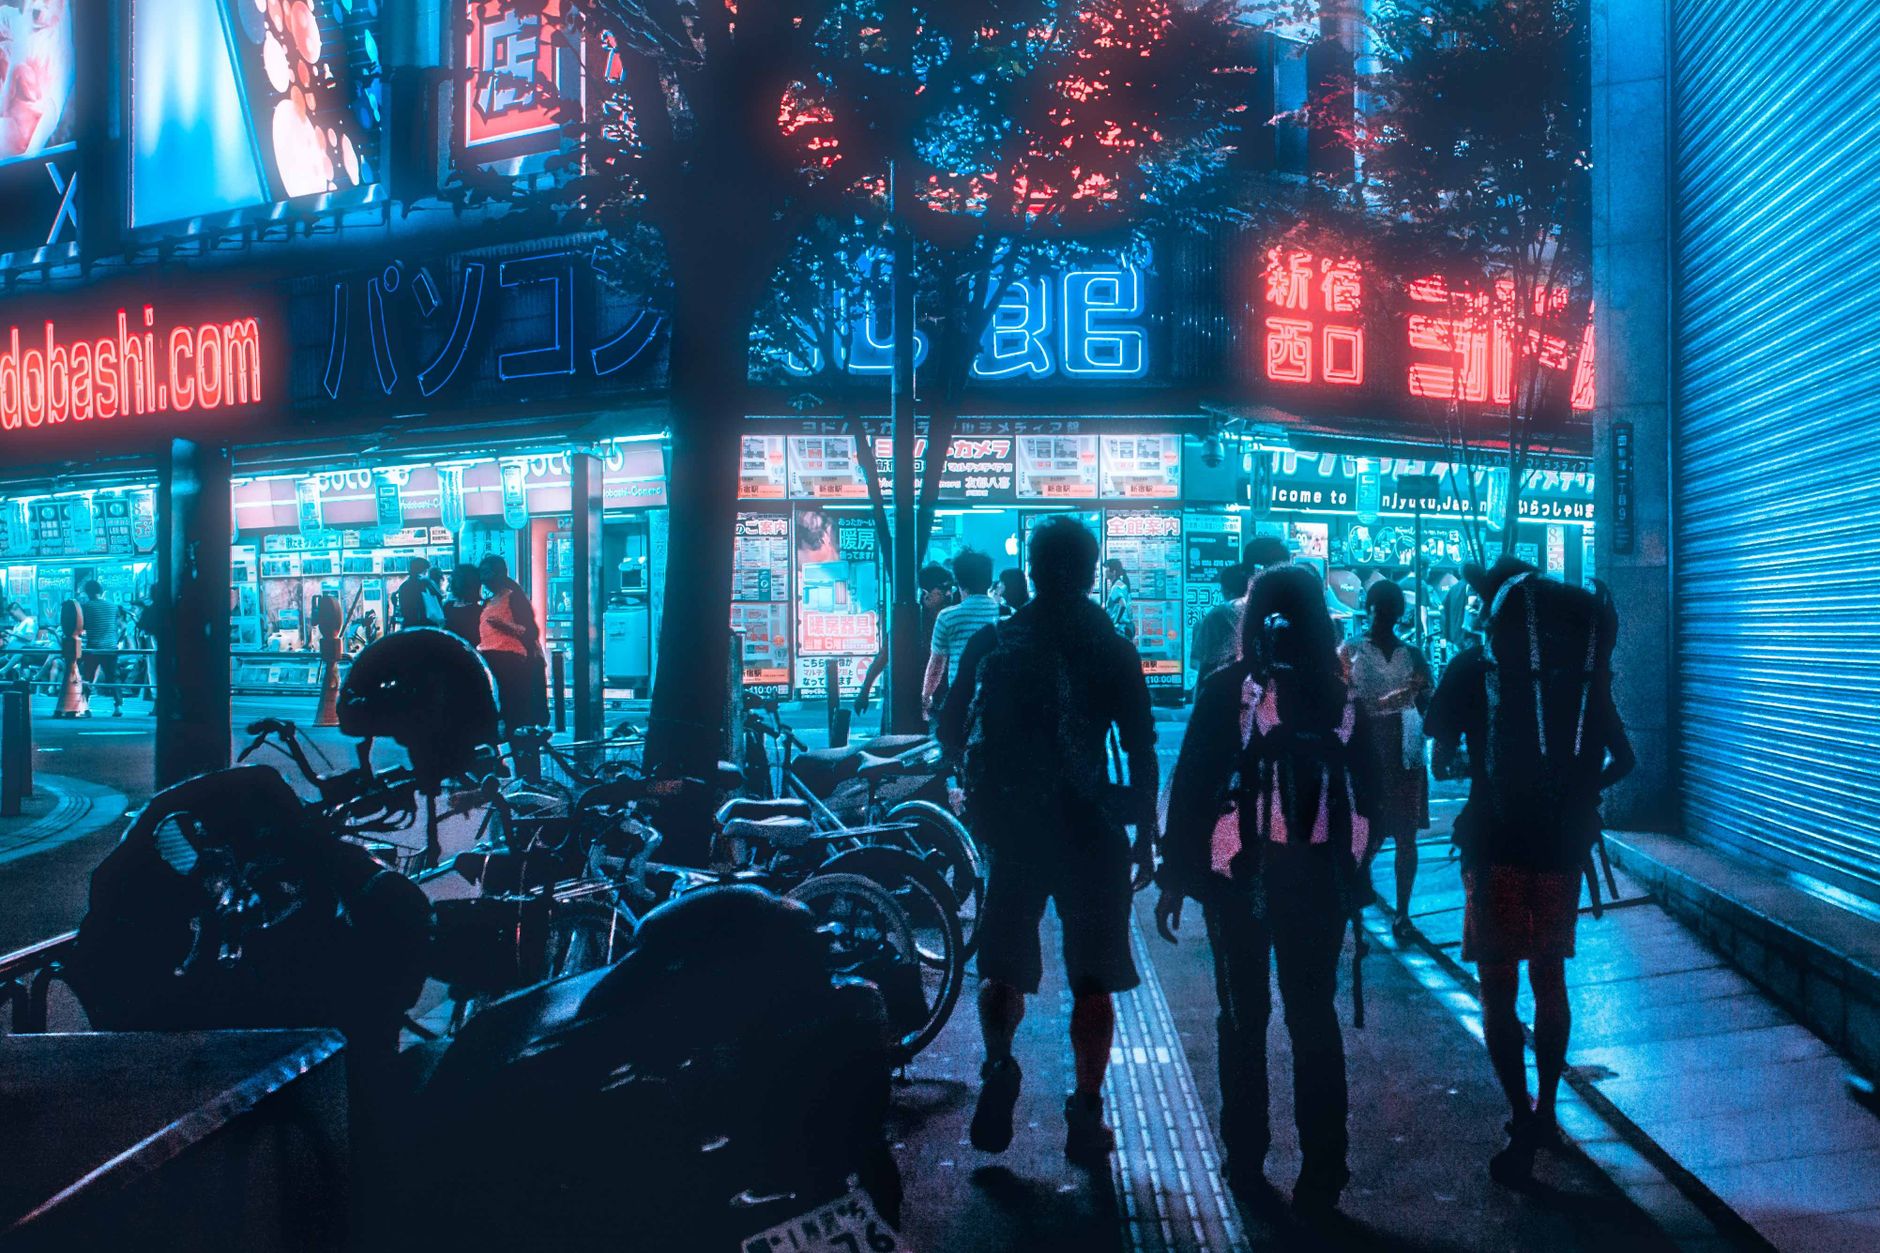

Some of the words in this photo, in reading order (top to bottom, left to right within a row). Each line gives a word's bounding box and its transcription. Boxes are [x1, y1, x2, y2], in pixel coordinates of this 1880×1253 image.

[1265, 246, 1363, 313] 新宿
[0, 305, 262, 430] dobashi.com
[1265, 316, 1365, 386] 西口
[1330, 490, 1348, 505] to
[838, 527, 875, 550] 暖房
[1107, 516, 1181, 536] 全館案内
